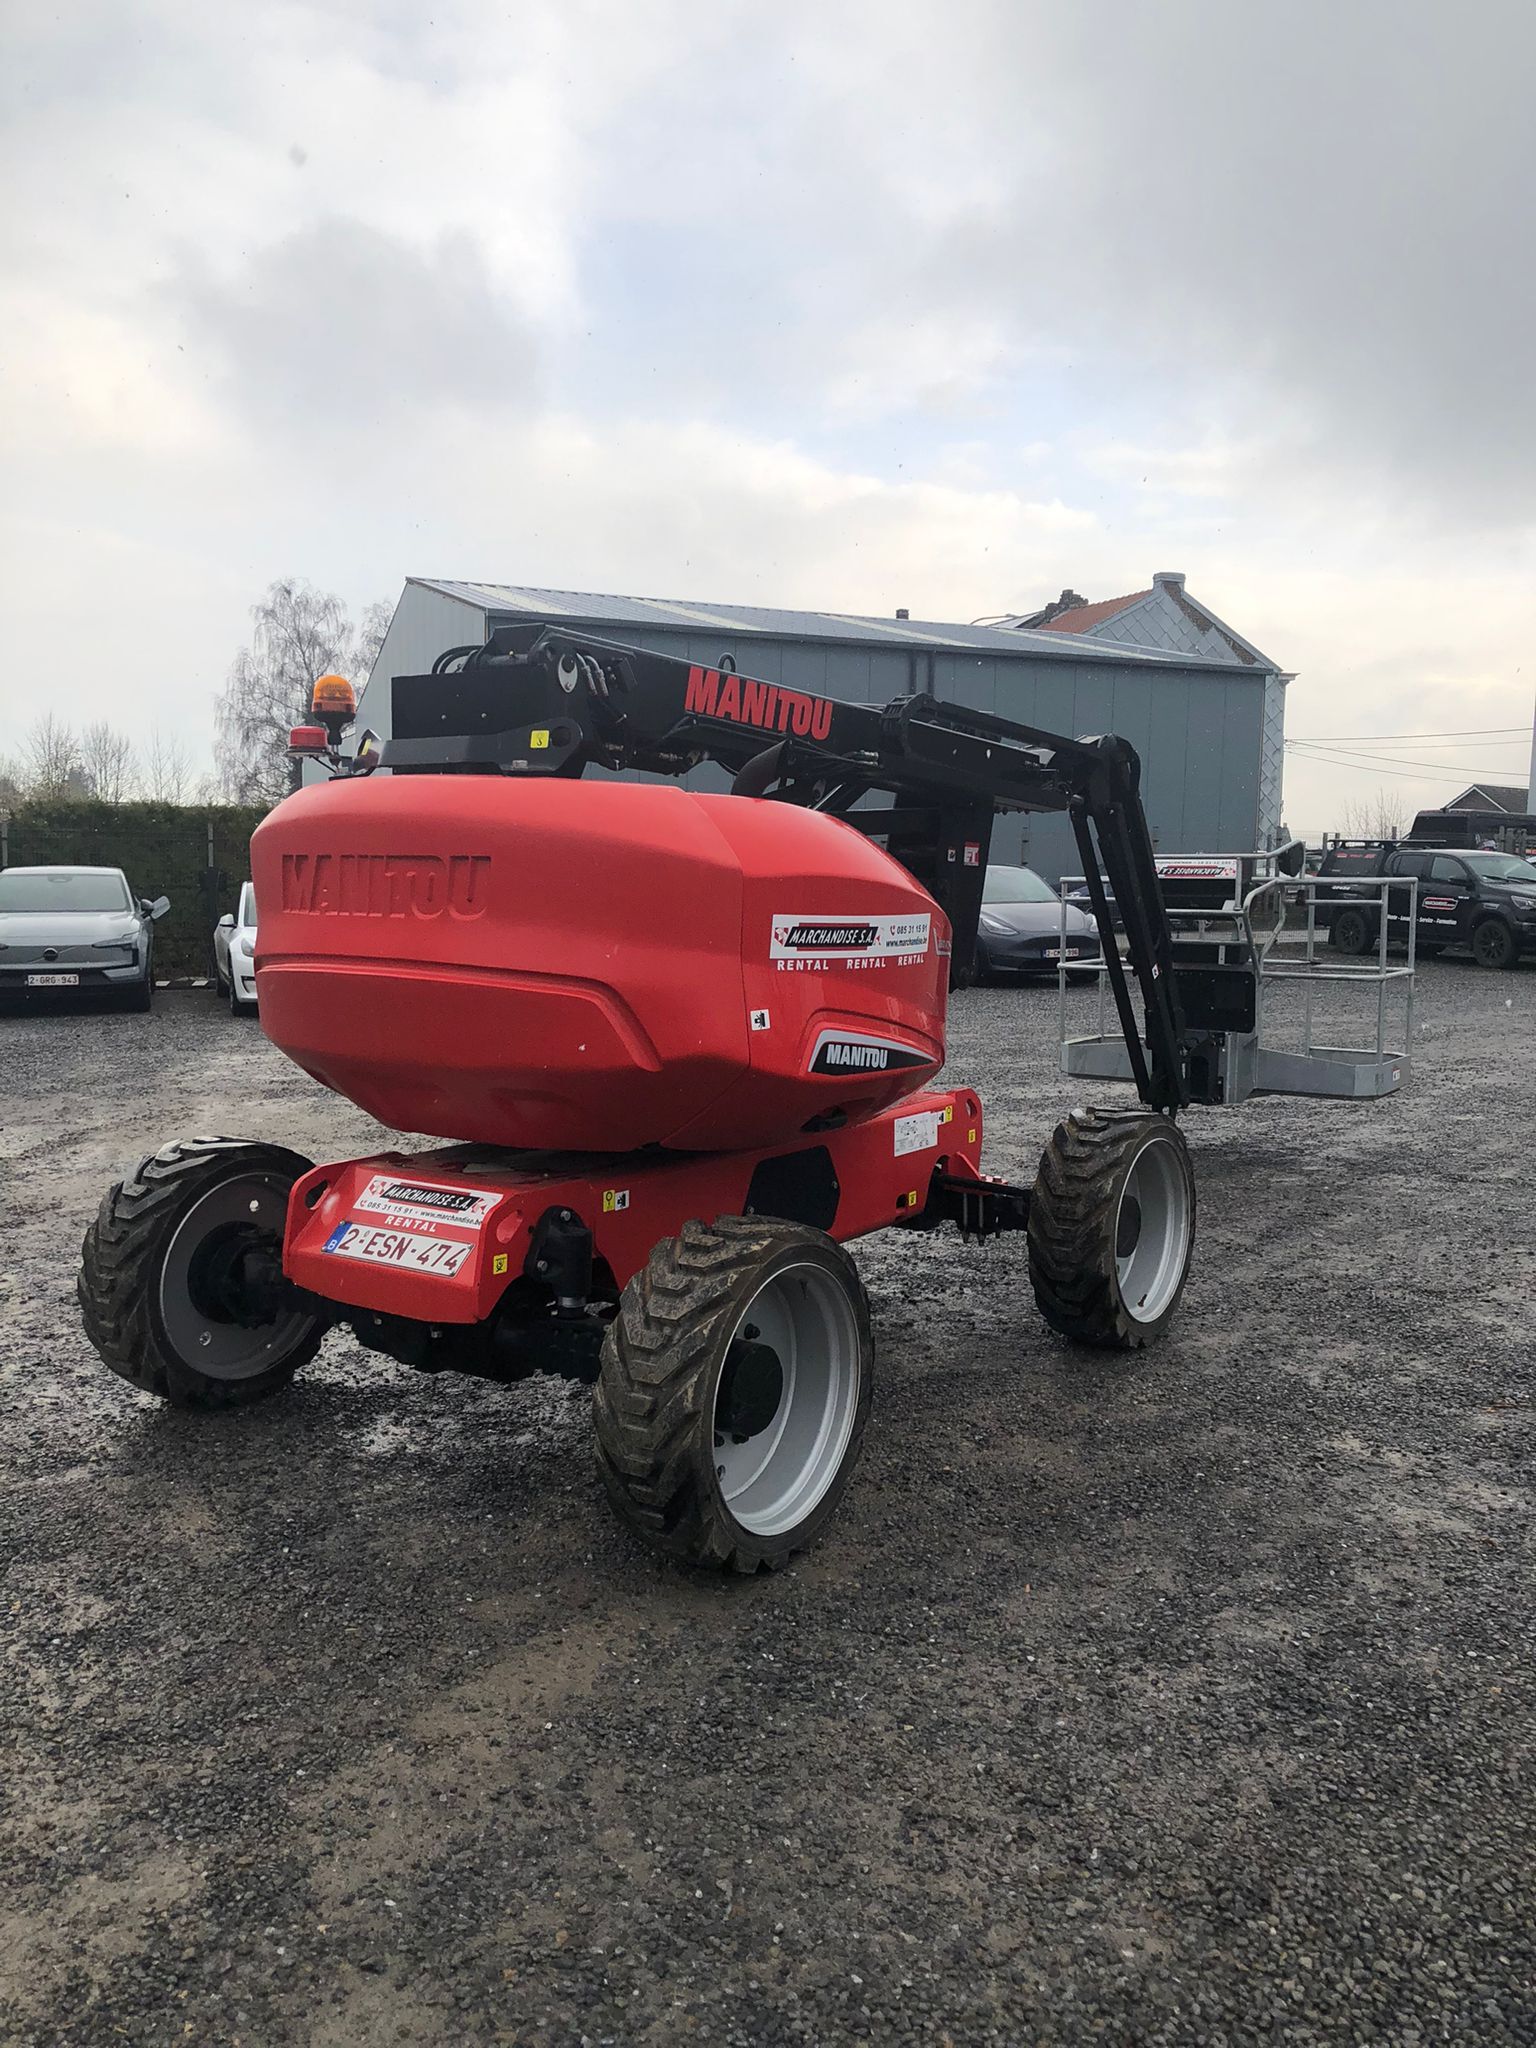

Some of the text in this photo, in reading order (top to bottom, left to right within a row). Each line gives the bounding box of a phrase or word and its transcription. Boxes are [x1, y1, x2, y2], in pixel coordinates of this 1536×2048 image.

[684, 665, 833, 740] MANITOU
[281, 854, 492, 920] MANITOU
[789, 928, 873, 945] MARCHANDISE S.A.
[896, 925, 907, 935] 085
[908, 925, 914, 934] 31
[777, 953, 925, 971] RENTAL RENTAL RENTAL
[826, 1043, 888, 1069] MANITOU
[367, 1202, 382, 1211] 085
[382, 1204, 391, 1212] 31
[393, 1205, 402, 1213] 15
[386, 1185, 469, 1210] MARCHANDISE S.A.
[384, 1216, 437, 1233] RENTAL
[327, 1229, 466, 1271] B 2-ESN-474
